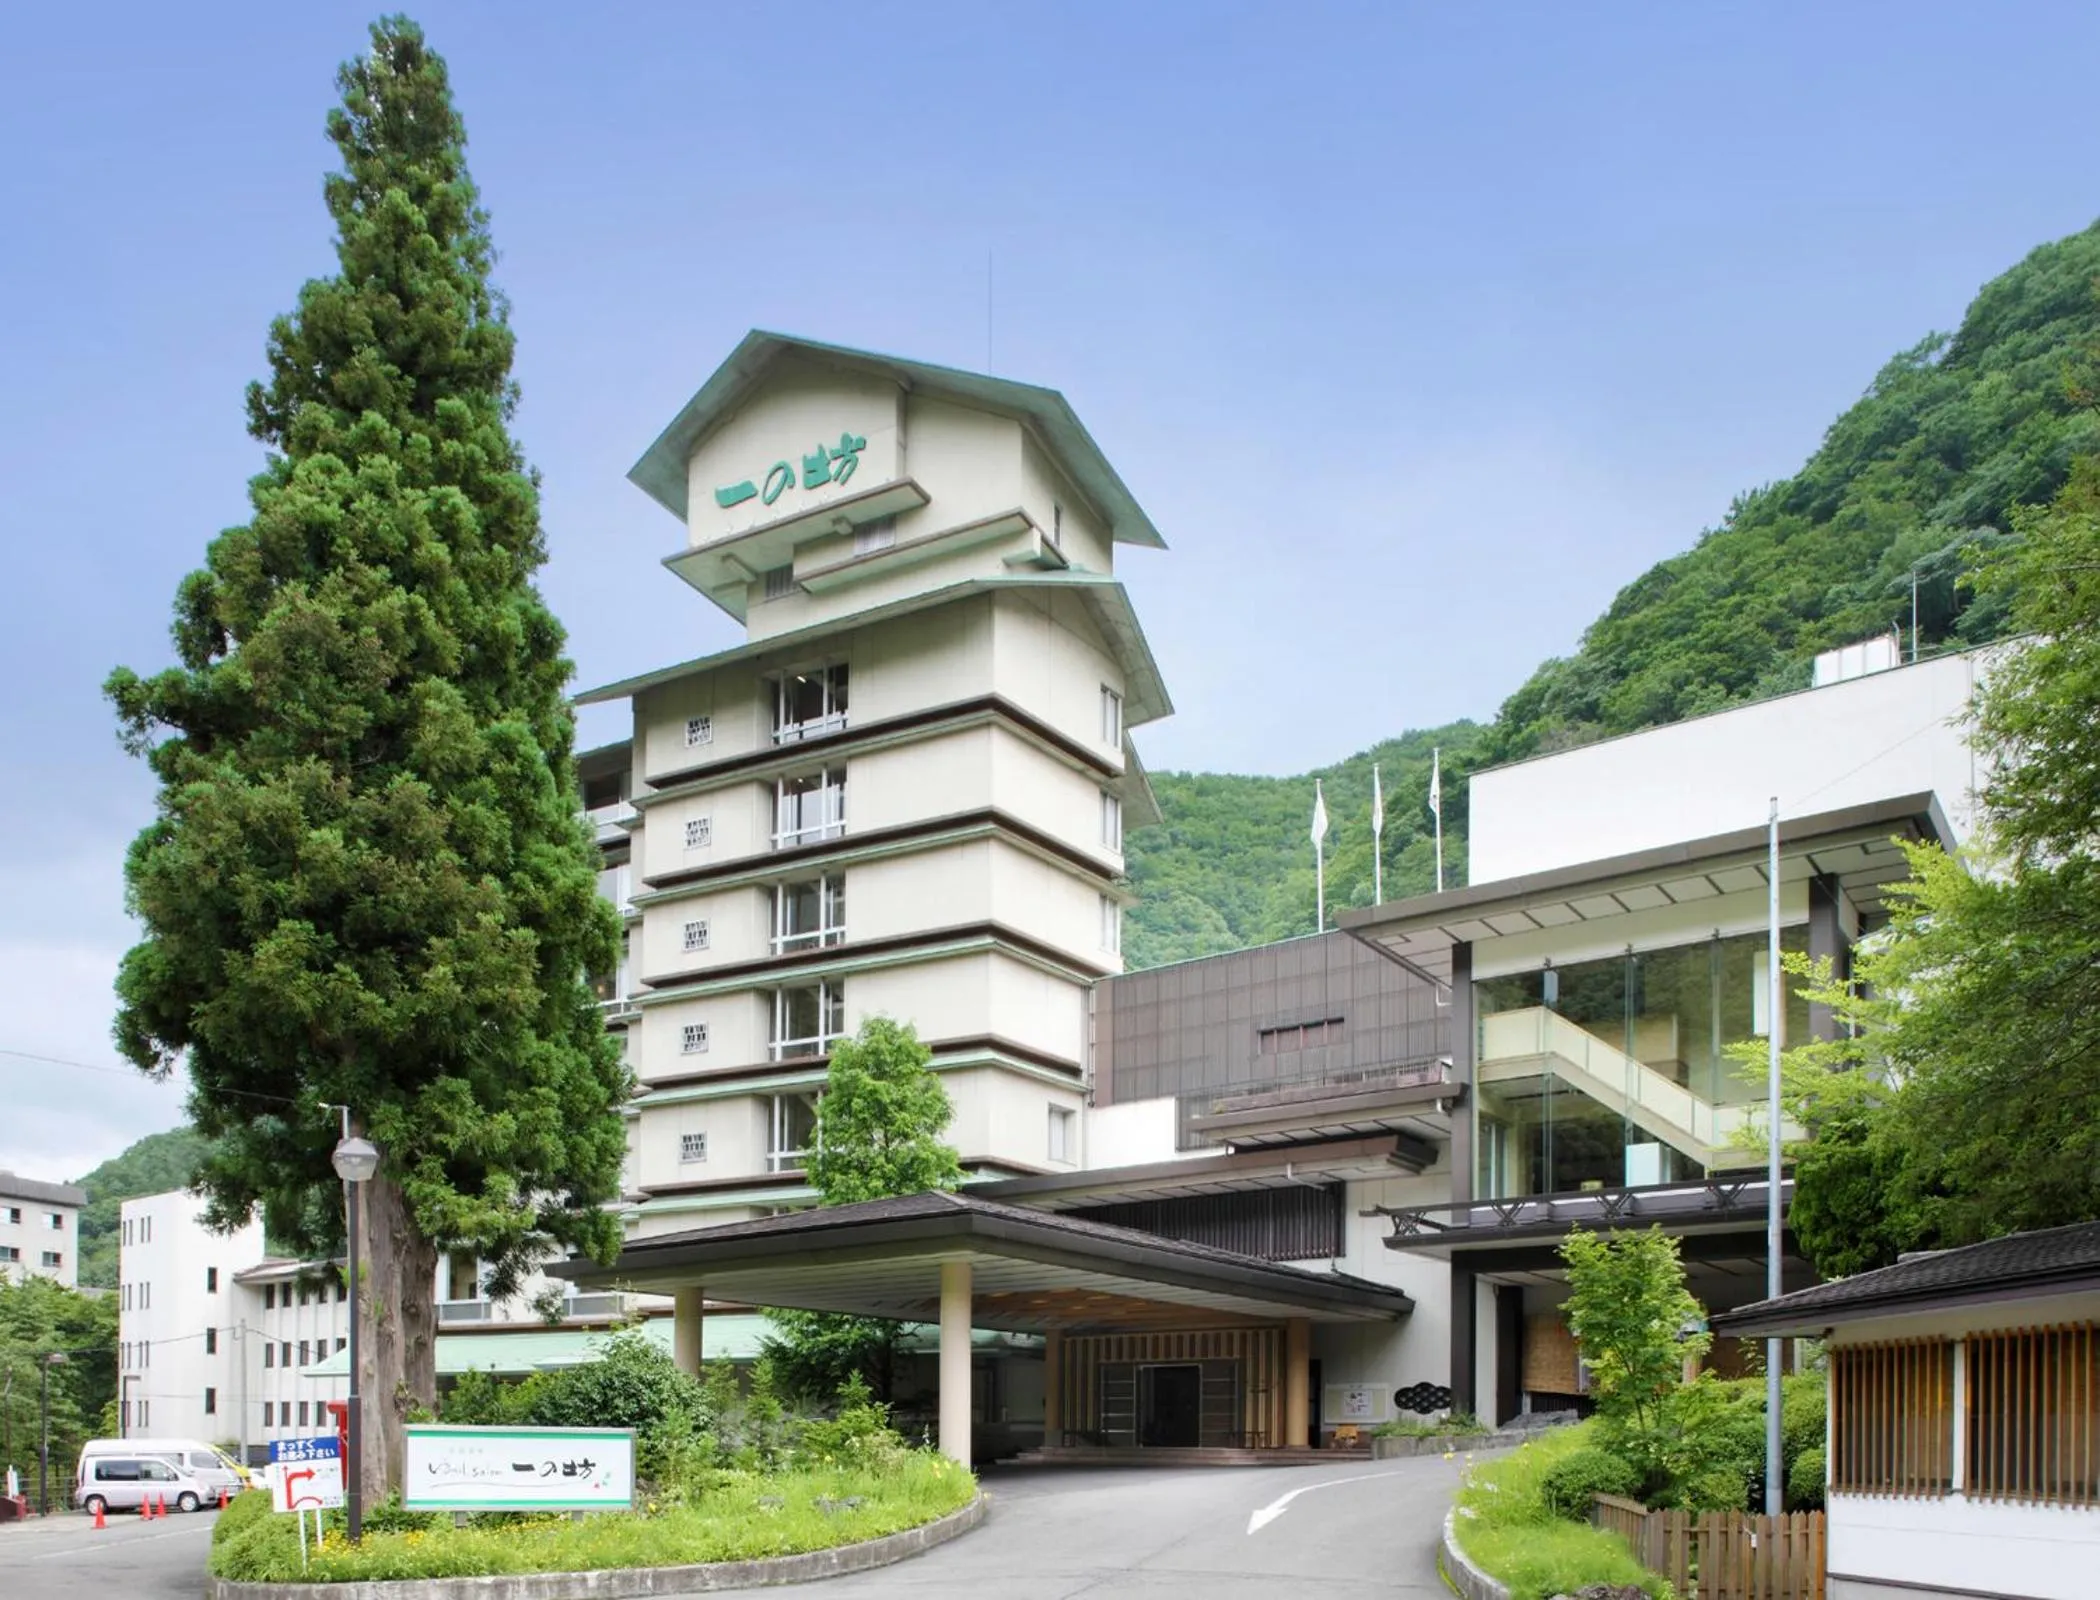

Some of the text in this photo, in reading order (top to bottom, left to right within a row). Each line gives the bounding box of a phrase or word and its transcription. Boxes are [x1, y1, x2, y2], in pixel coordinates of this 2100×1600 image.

[715, 432, 867, 508] 一の坊
[512, 1458, 596, 1479] 一の坊
